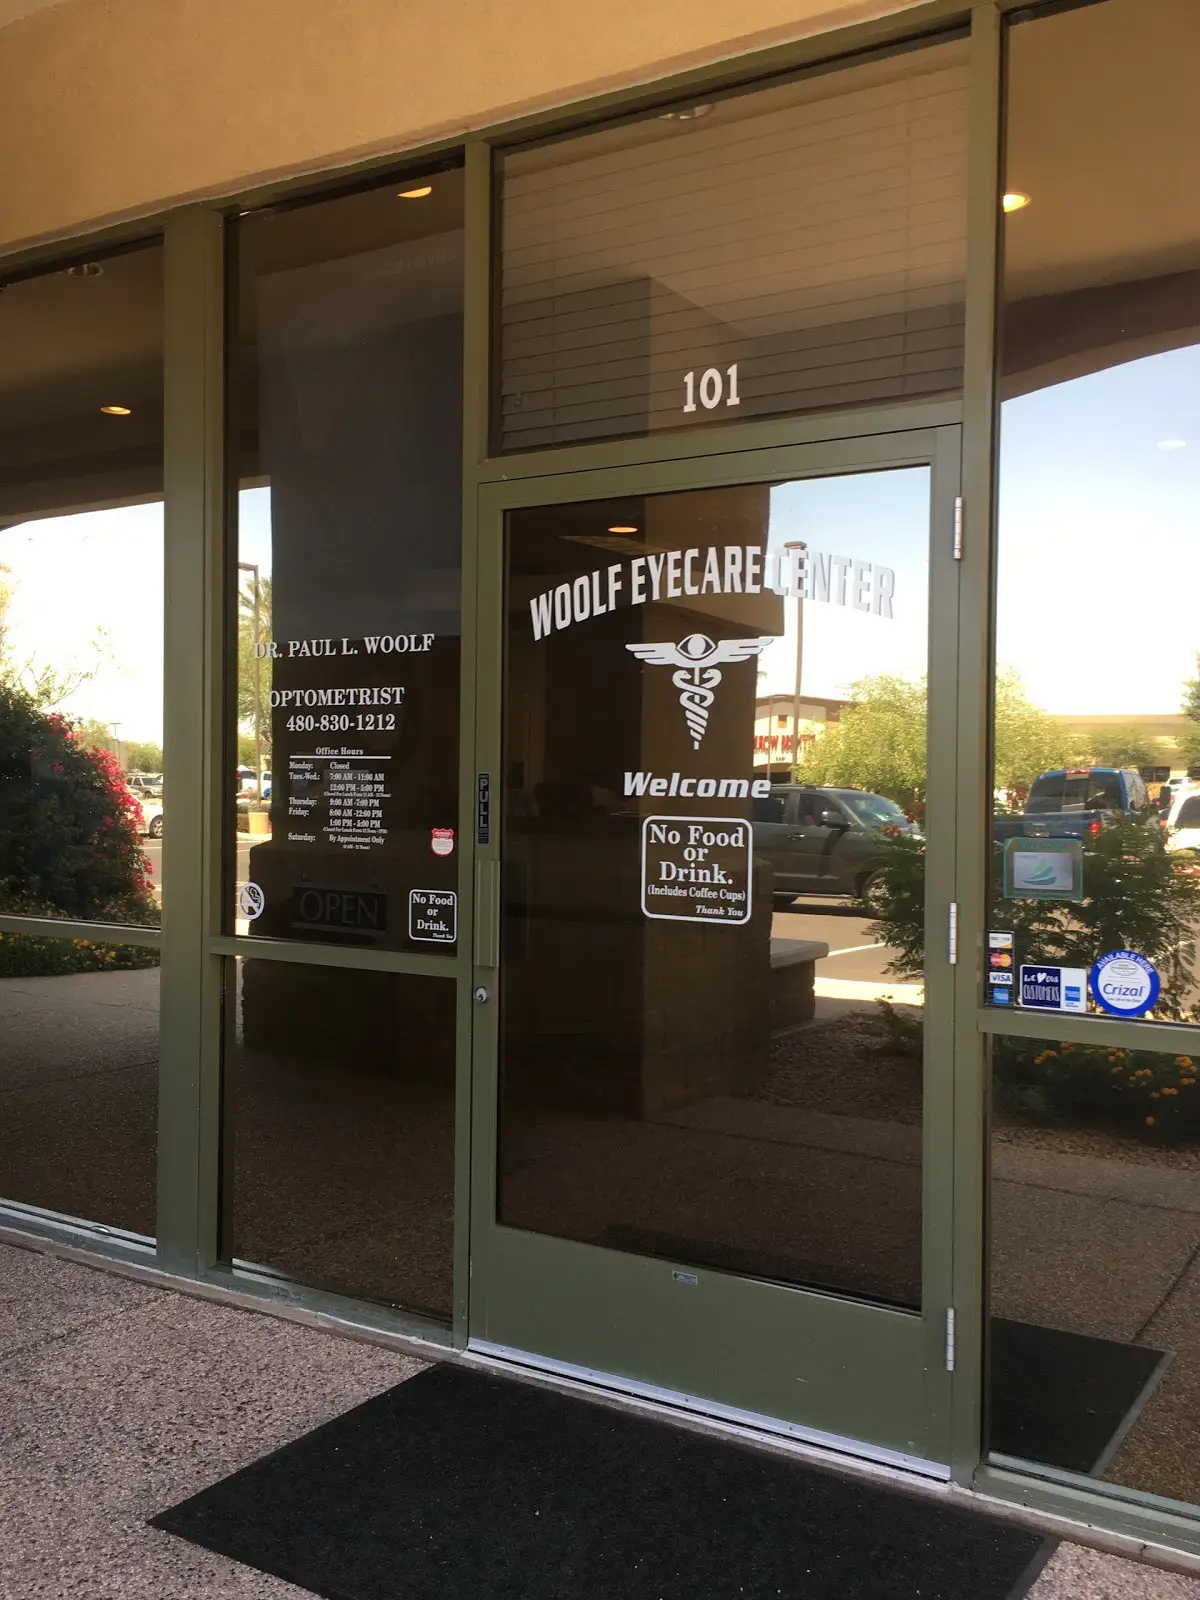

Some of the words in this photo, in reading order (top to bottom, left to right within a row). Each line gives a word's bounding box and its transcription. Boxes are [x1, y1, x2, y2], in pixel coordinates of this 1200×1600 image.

[683, 363, 740, 413] 101
[529, 563, 622, 642] WOOLF
[631, 545, 762, 606] EYECARE
[771, 547, 895, 619] CENTER
[254, 641, 283, 659] DR.
[288, 638, 336, 658] PAUL
[341, 638, 358, 655] L.
[364, 633, 435, 654] WOOLF
[269, 686, 405, 708] OPTOMETRIST
[286, 713, 396, 732] 480-830-1212
[315, 747, 339, 755] Office
[341, 747, 364, 755] Hours
[289, 761, 314, 770] Monday:
[329, 762, 350, 770] Closed
[342, 773, 353, 781] AM
[373, 773, 385, 781] AM
[346, 784, 356, 792] PM
[373, 784, 385, 792] PM
[623, 771, 772, 799] Welcome
[288, 797, 318, 806] Thursday:
[368, 799, 380, 807] PM
[479, 778, 489, 828] PULL
[288, 807, 310, 817] Friday:
[342, 809, 353, 817] AM
[372, 810, 383, 818] PM
[342, 819, 353, 827] PM
[370, 820, 381, 828] PM
[288, 832, 316, 842] Saturday:
[329, 834, 337, 842] By
[337, 835, 371, 843] Appointment
[371, 836, 385, 845] Only
[649, 824, 681, 845] No
[687, 825, 745, 848] Food
[683, 847, 709, 862] or
[659, 861, 733, 885] Drink.
[412, 893, 427, 904] No
[429, 894, 454, 906] Food
[647, 884, 688, 898] (Includes
[689, 886, 718, 900] Coffee
[719, 889, 746, 902] Cups)
[301, 890, 378, 927] OPEN
[426, 908, 439, 916] or
[695, 904, 725, 916] Thank
[727, 907, 744, 917] You
[416, 919, 449, 931] Drink.
[1096, 951, 1136, 970] AVAILABLE
[1136, 957, 1155, 975] HERE
[992, 974, 1011, 982] VISA
[1023, 984, 1060, 1001] CUSTOMERS
[1102, 983, 1144, 997] Crizal
